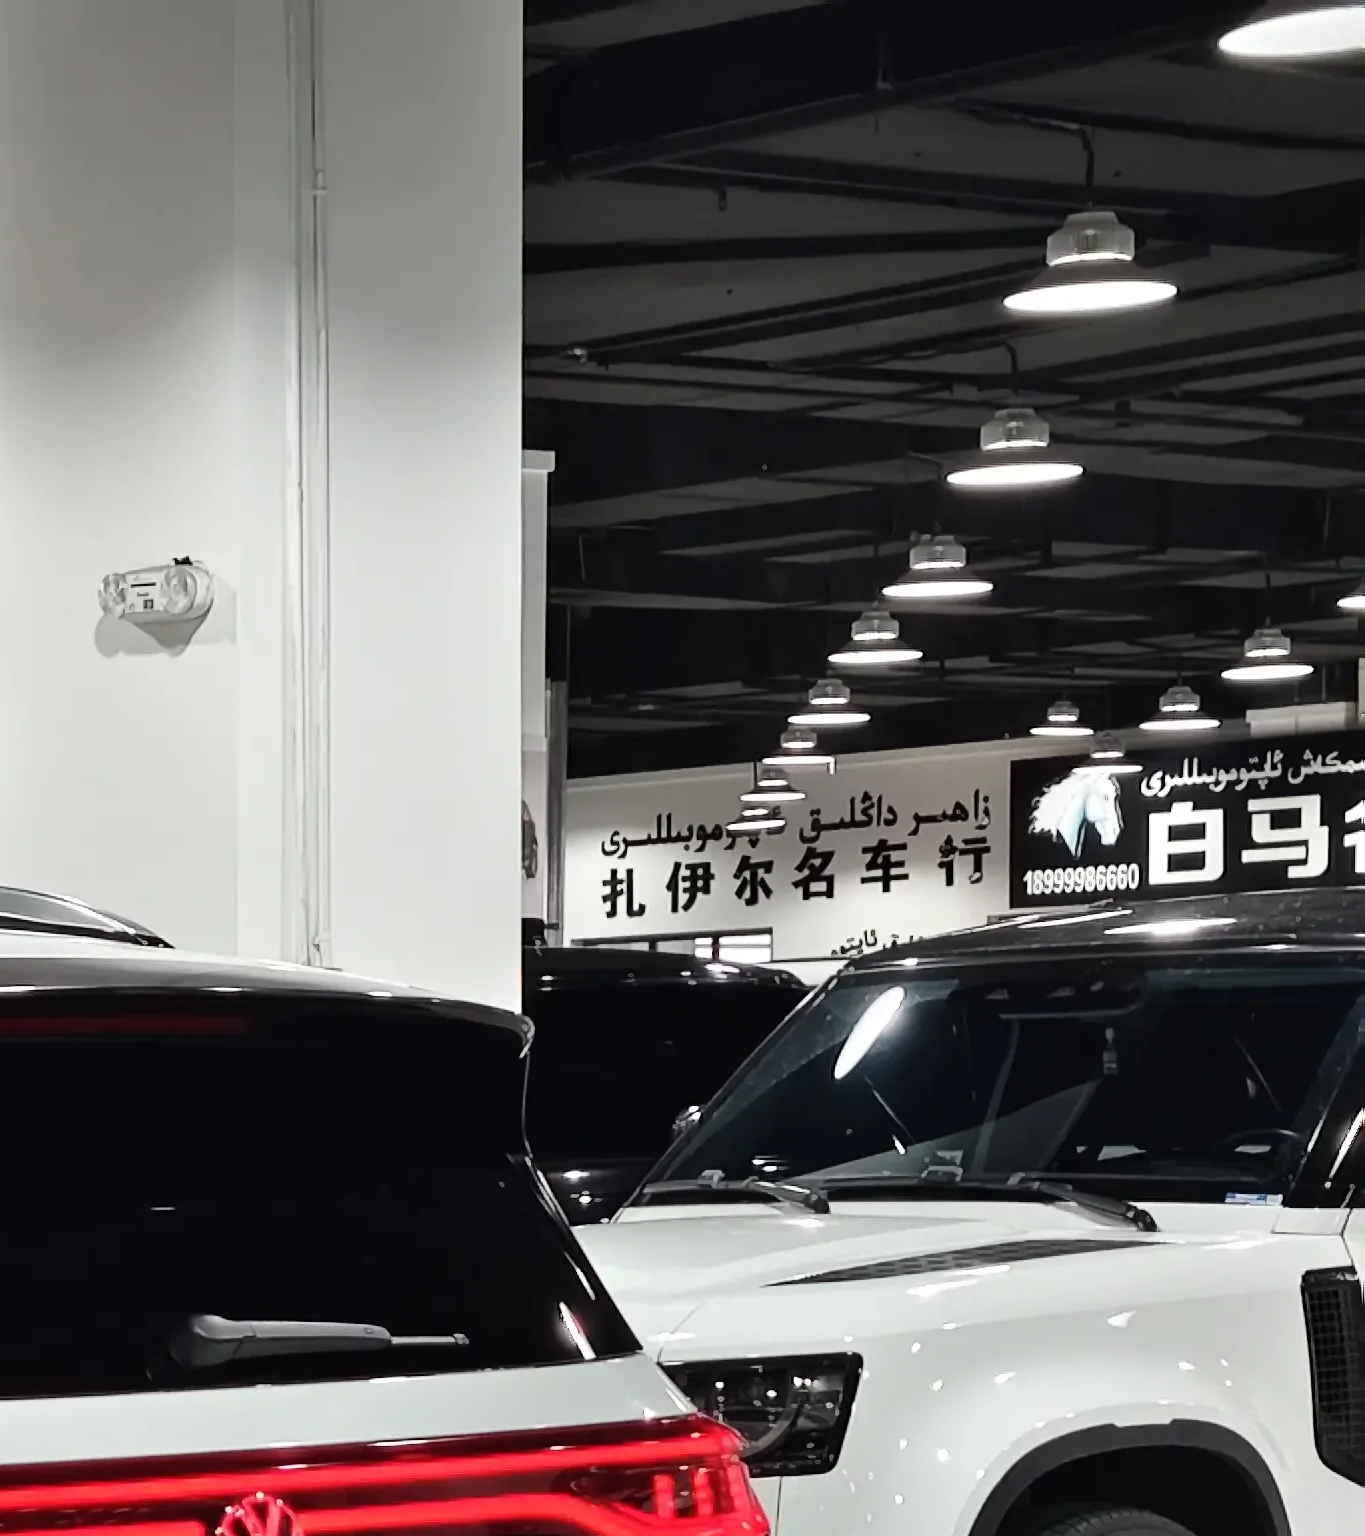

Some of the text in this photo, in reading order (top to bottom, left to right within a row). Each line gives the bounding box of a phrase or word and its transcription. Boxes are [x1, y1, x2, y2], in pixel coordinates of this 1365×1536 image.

[601, 834, 991, 918] 扎伊尔名车行
